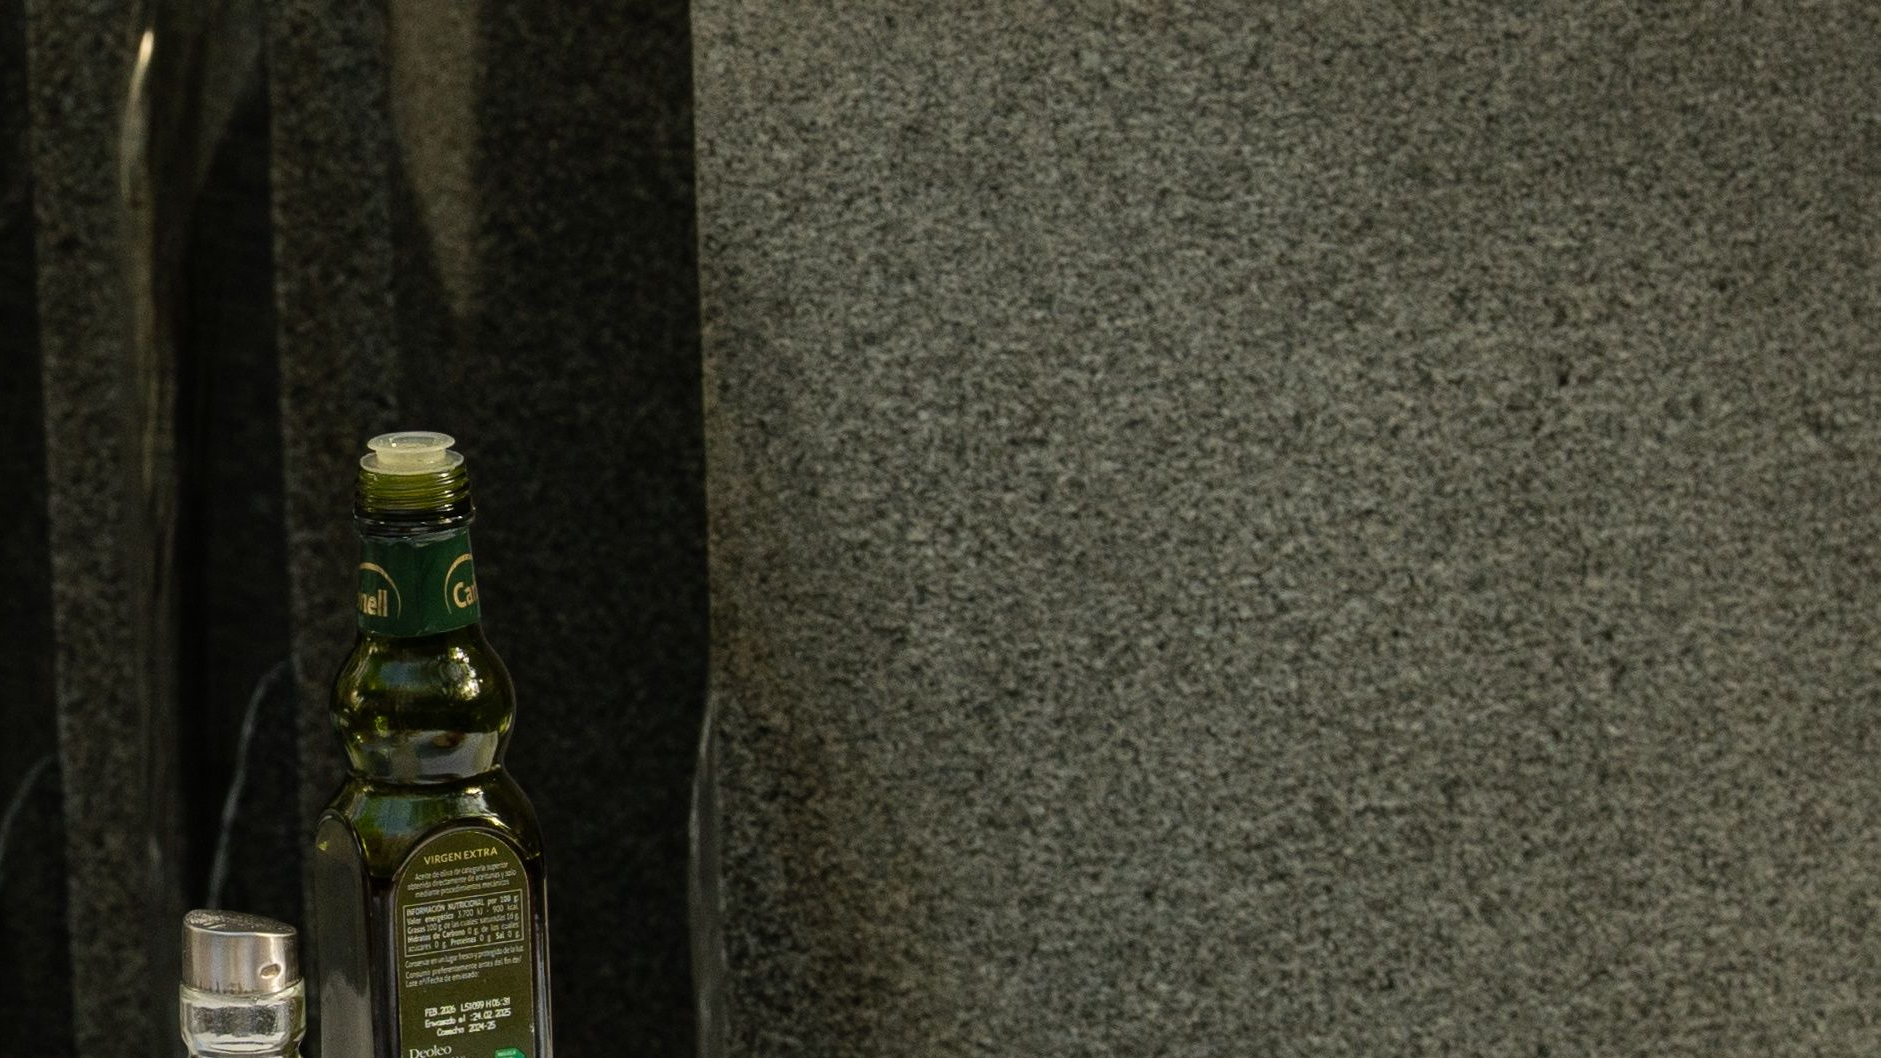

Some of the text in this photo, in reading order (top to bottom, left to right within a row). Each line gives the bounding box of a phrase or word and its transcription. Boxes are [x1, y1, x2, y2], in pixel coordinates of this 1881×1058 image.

[424, 846, 498, 865] VIRGEN EXTRA
[406, 904, 446, 916] INFORMACIÓN
[448, 898, 484, 910] NUTRICIONAL
[487, 898, 497, 906] por
[425, 1017, 456, 1029] Envasado
